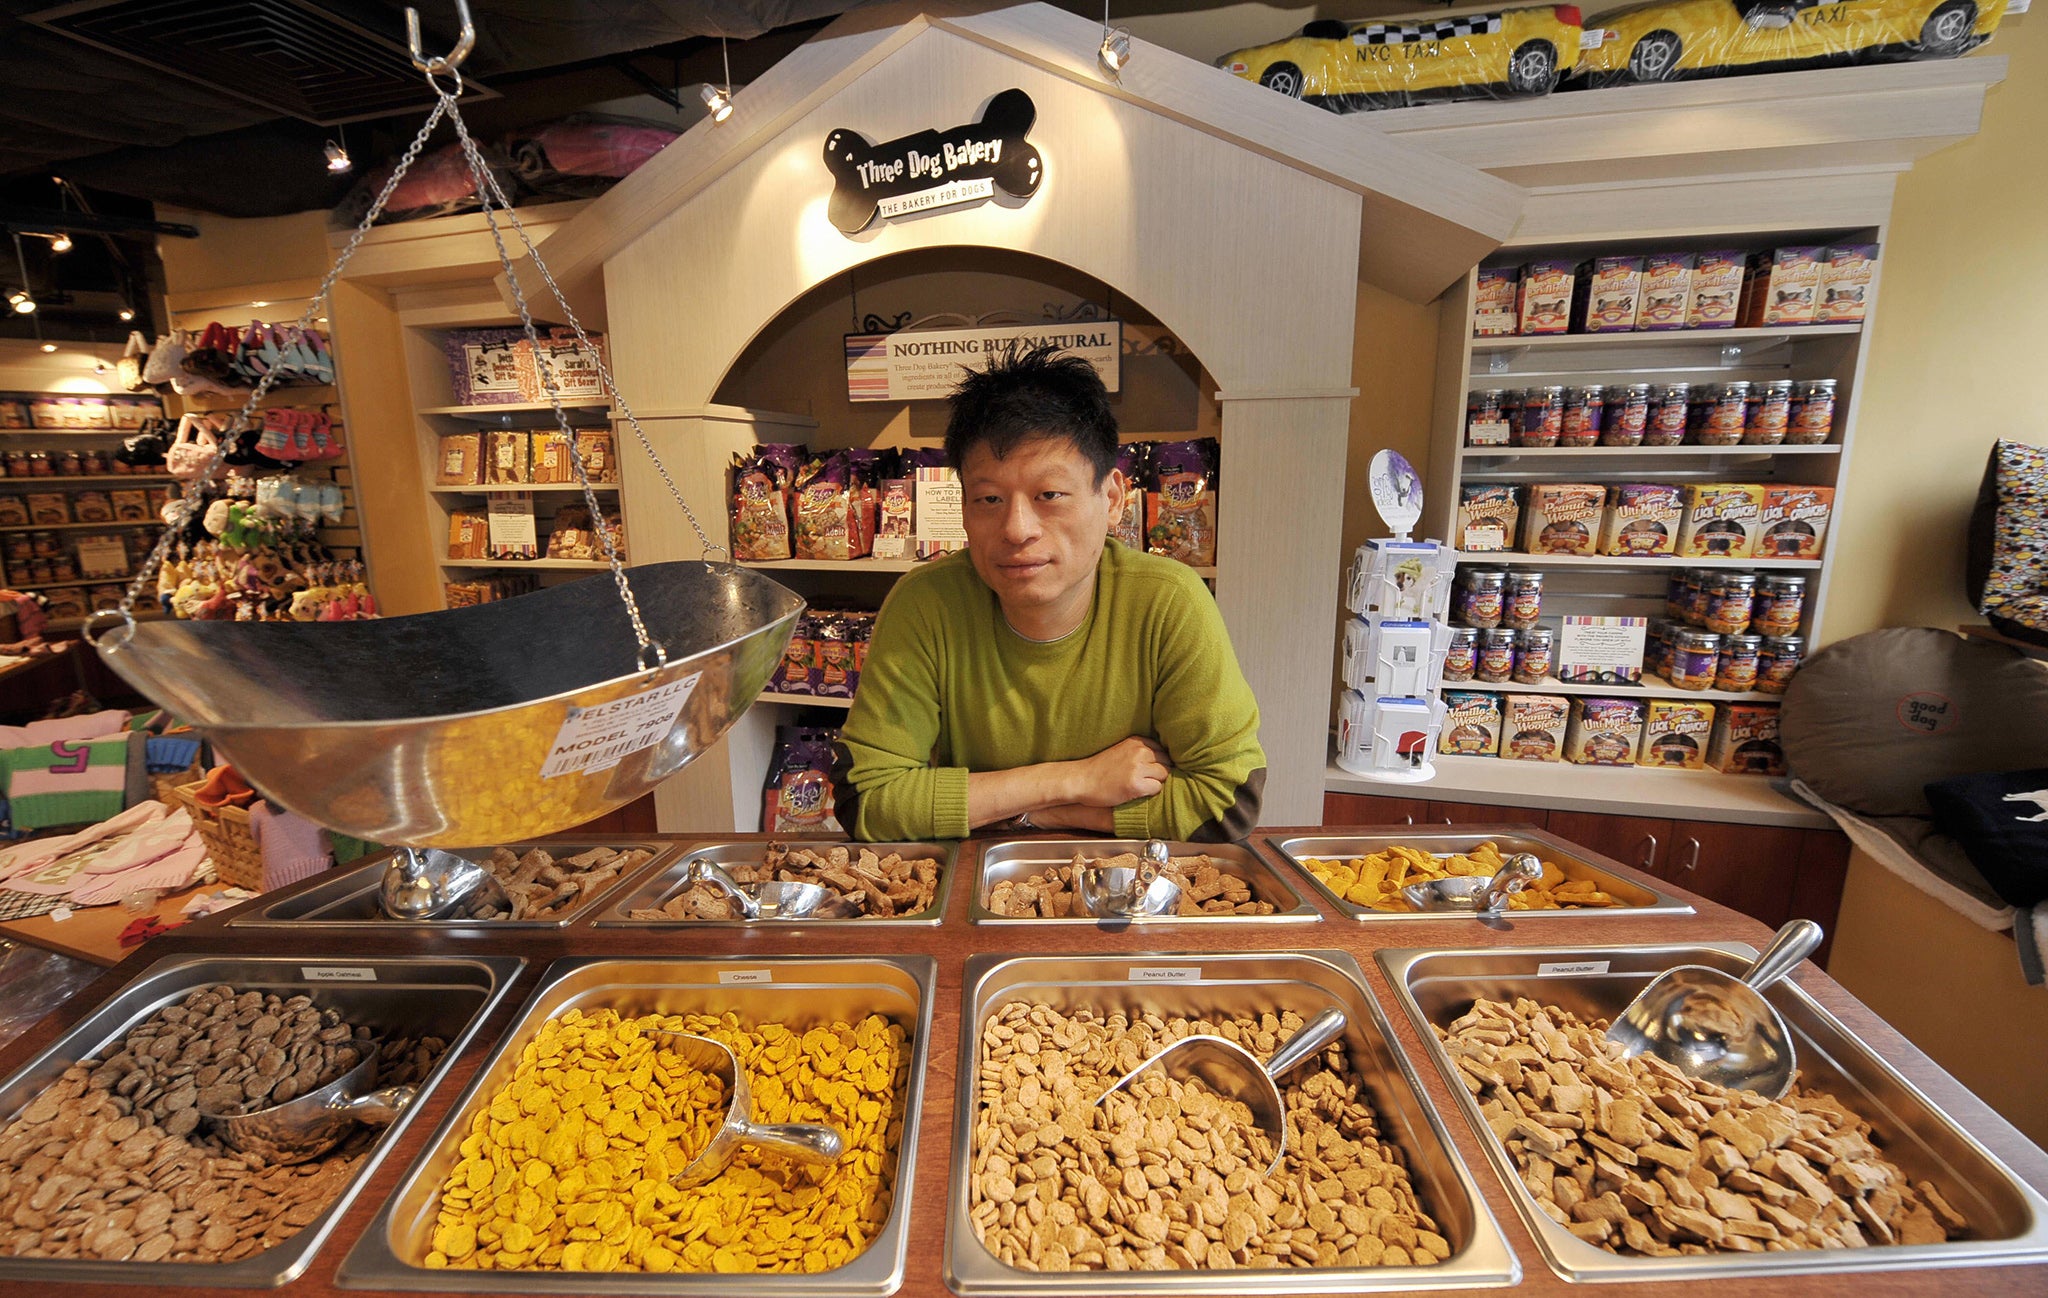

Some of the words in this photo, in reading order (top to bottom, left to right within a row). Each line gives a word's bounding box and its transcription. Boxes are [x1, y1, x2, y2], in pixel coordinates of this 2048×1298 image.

[1801, 6, 1847, 26] TAXI
[1356, 45, 1391, 62] NYC
[1403, 42, 1441, 59] TAXI
[856, 157, 904, 189] Three
[908, 150, 941, 179] Dog
[942, 138, 1003, 172] Bakery
[882, 203, 899, 216] THE
[902, 194, 936, 211] BAKERY
[940, 189, 958, 201] FOR
[961, 182, 986, 197] DOGS
[894, 339, 979, 358] NOTHING
[983, 337, 1019, 352] BUT
[1023, 333, 1112, 350] NATURAL
[563, 378, 576, 388] Gift
[1463, 498, 1502, 512] Vanilla
[1543, 500, 1587, 514] Peanut
[1469, 506, 1513, 521] Woofers
[1546, 508, 1595, 523] Woofers
[825, 527, 846, 537] Adult
[663, 677, 698, 697] LLC
[1448, 706, 1487, 719] Vanilla
[1909, 701, 1949, 714] good
[1454, 714, 1496, 728] Woofers
[1514, 711, 1553, 724] Peanut
[1517, 718, 1561, 732] Woofers
[1910, 711, 1938, 731] dog
[554, 729, 629, 757] MODEL
[636, 712, 675, 732] 7908
